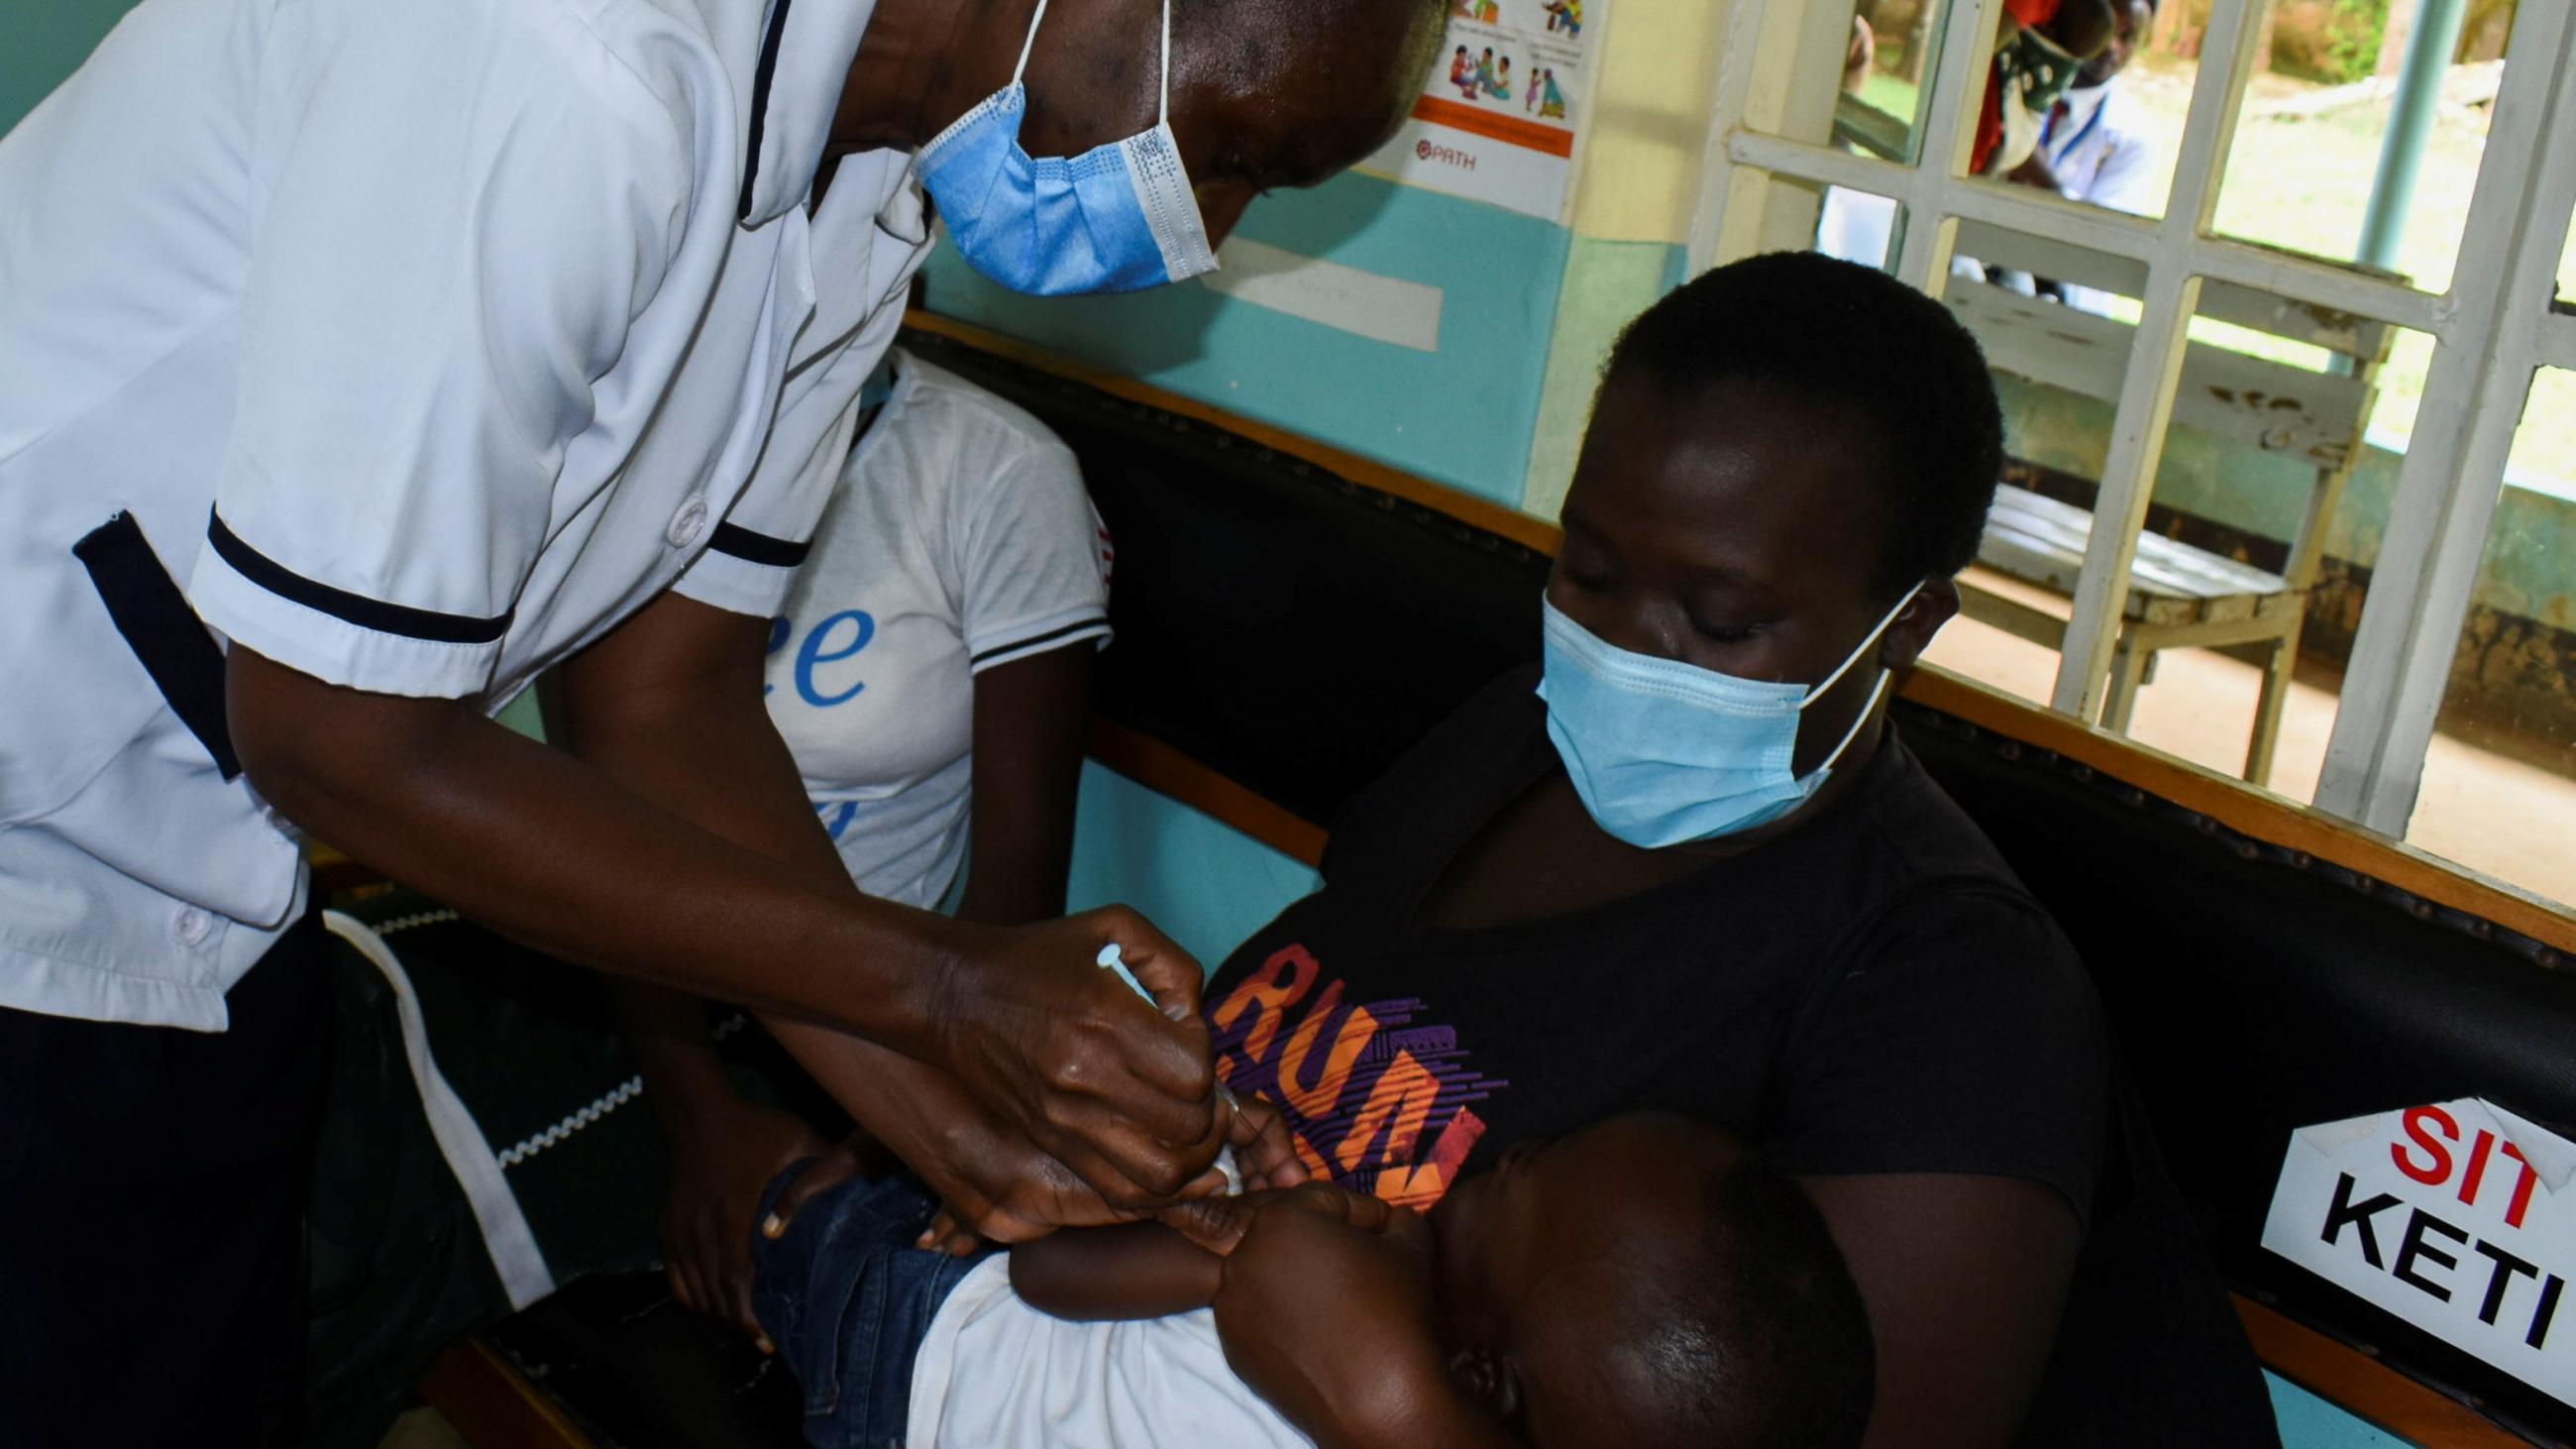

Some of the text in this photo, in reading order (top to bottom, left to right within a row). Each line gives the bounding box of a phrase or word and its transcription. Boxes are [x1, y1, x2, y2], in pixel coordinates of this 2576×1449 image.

[1431, 145, 1477, 170] PATH
[1213, 943, 1487, 1215] RUN
[2391, 1104, 2538, 1229] SIT
[2320, 1170, 2565, 1351] KETI
